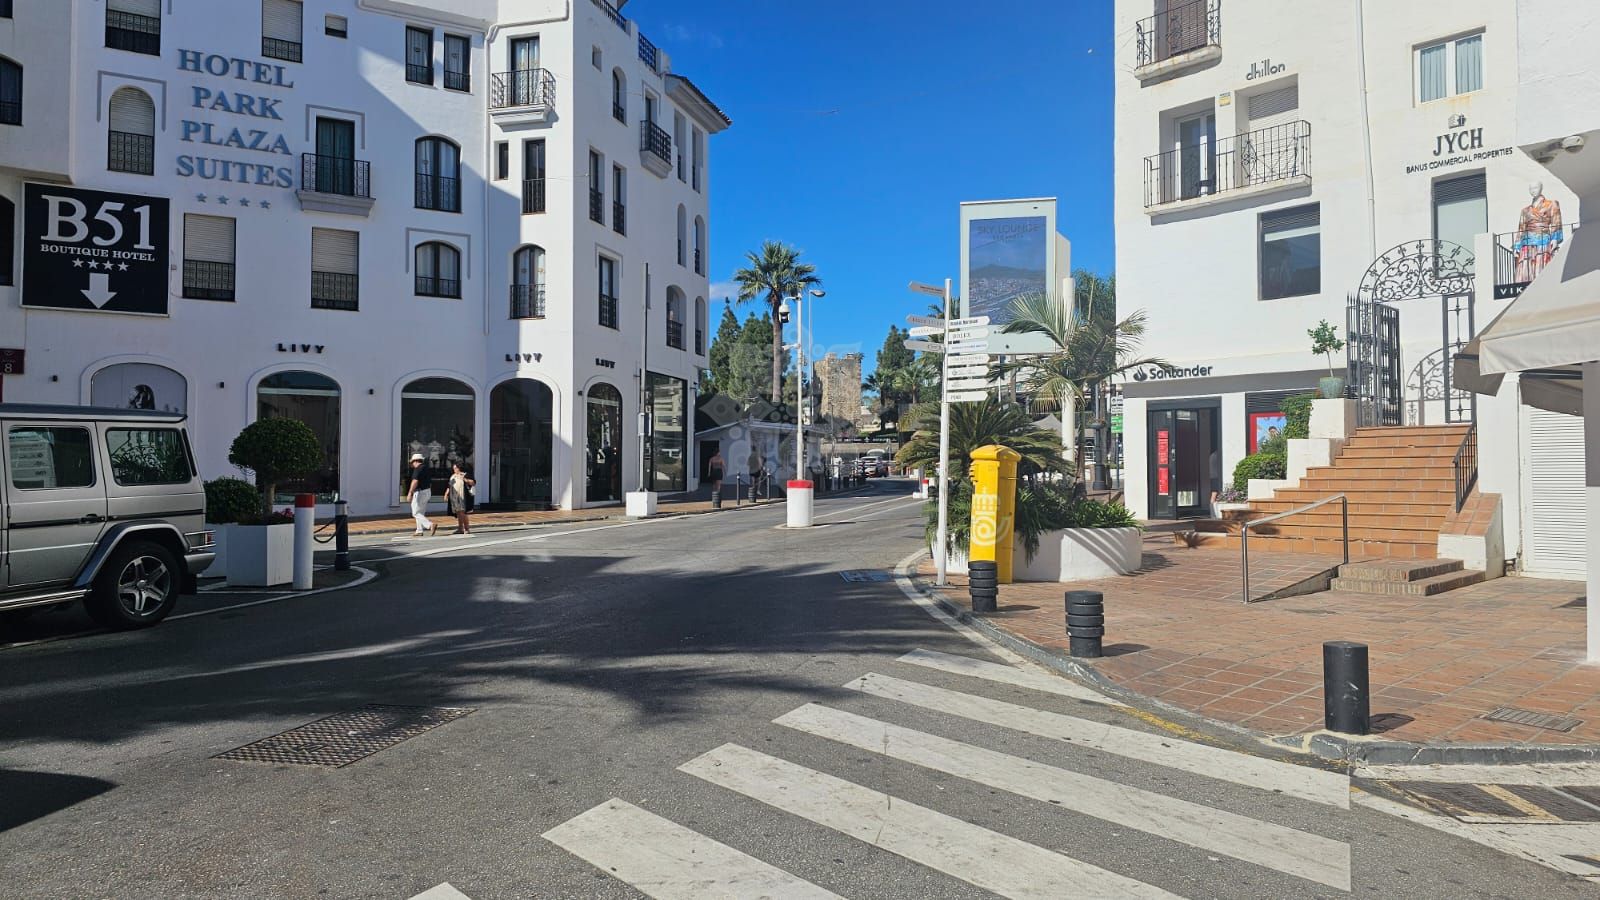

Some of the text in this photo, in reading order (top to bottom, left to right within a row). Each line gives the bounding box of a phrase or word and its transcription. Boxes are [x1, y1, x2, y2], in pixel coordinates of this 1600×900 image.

[177, 49, 294, 88] HOTEL
[1246, 58, 1286, 80] dhillon
[191, 86, 284, 120] PARK
[180, 119, 293, 155] PLAZA
[1433, 127, 1484, 156] JYCH
[176, 154, 293, 189] SUITES
[1406, 146, 1513, 174] BANUS COMMERCIAL PROPERTIES
[40, 194, 156, 250] B51
[40, 243, 155, 262] BOUTIQUE HOTEL
[278, 343, 325, 354] LIVY
[505, 353, 543, 362] LIVY
[3, 362, 13, 374] 8
[595, 358, 616, 368] LIVY
[1149, 365, 1213, 379] Santander
